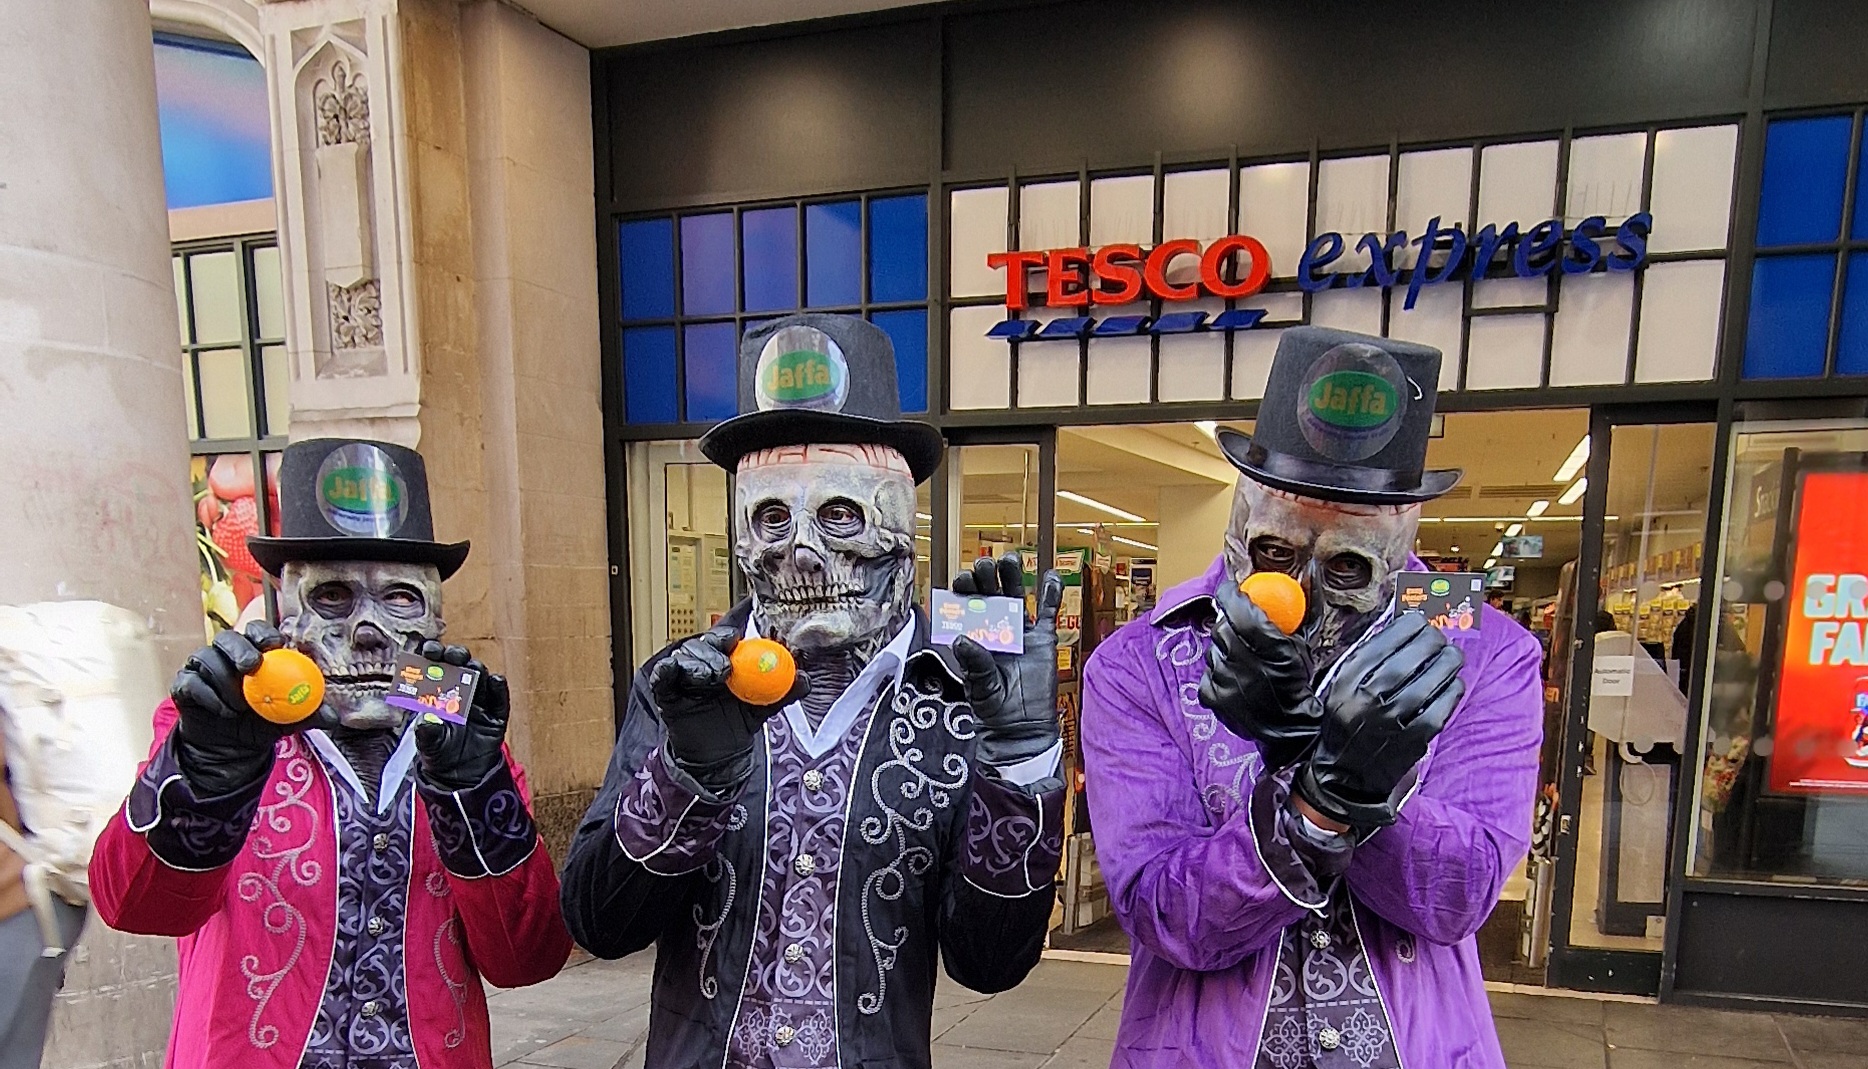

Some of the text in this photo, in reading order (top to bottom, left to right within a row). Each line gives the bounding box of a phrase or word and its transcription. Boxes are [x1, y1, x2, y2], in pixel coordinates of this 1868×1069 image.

[987, 211, 1652, 311] TESCO express
[766, 359, 831, 392] Jaffa
[1314, 381, 1389, 416] Jaffa
[1803, 574, 1868, 619] GR
[1808, 621, 1868, 666] FA
